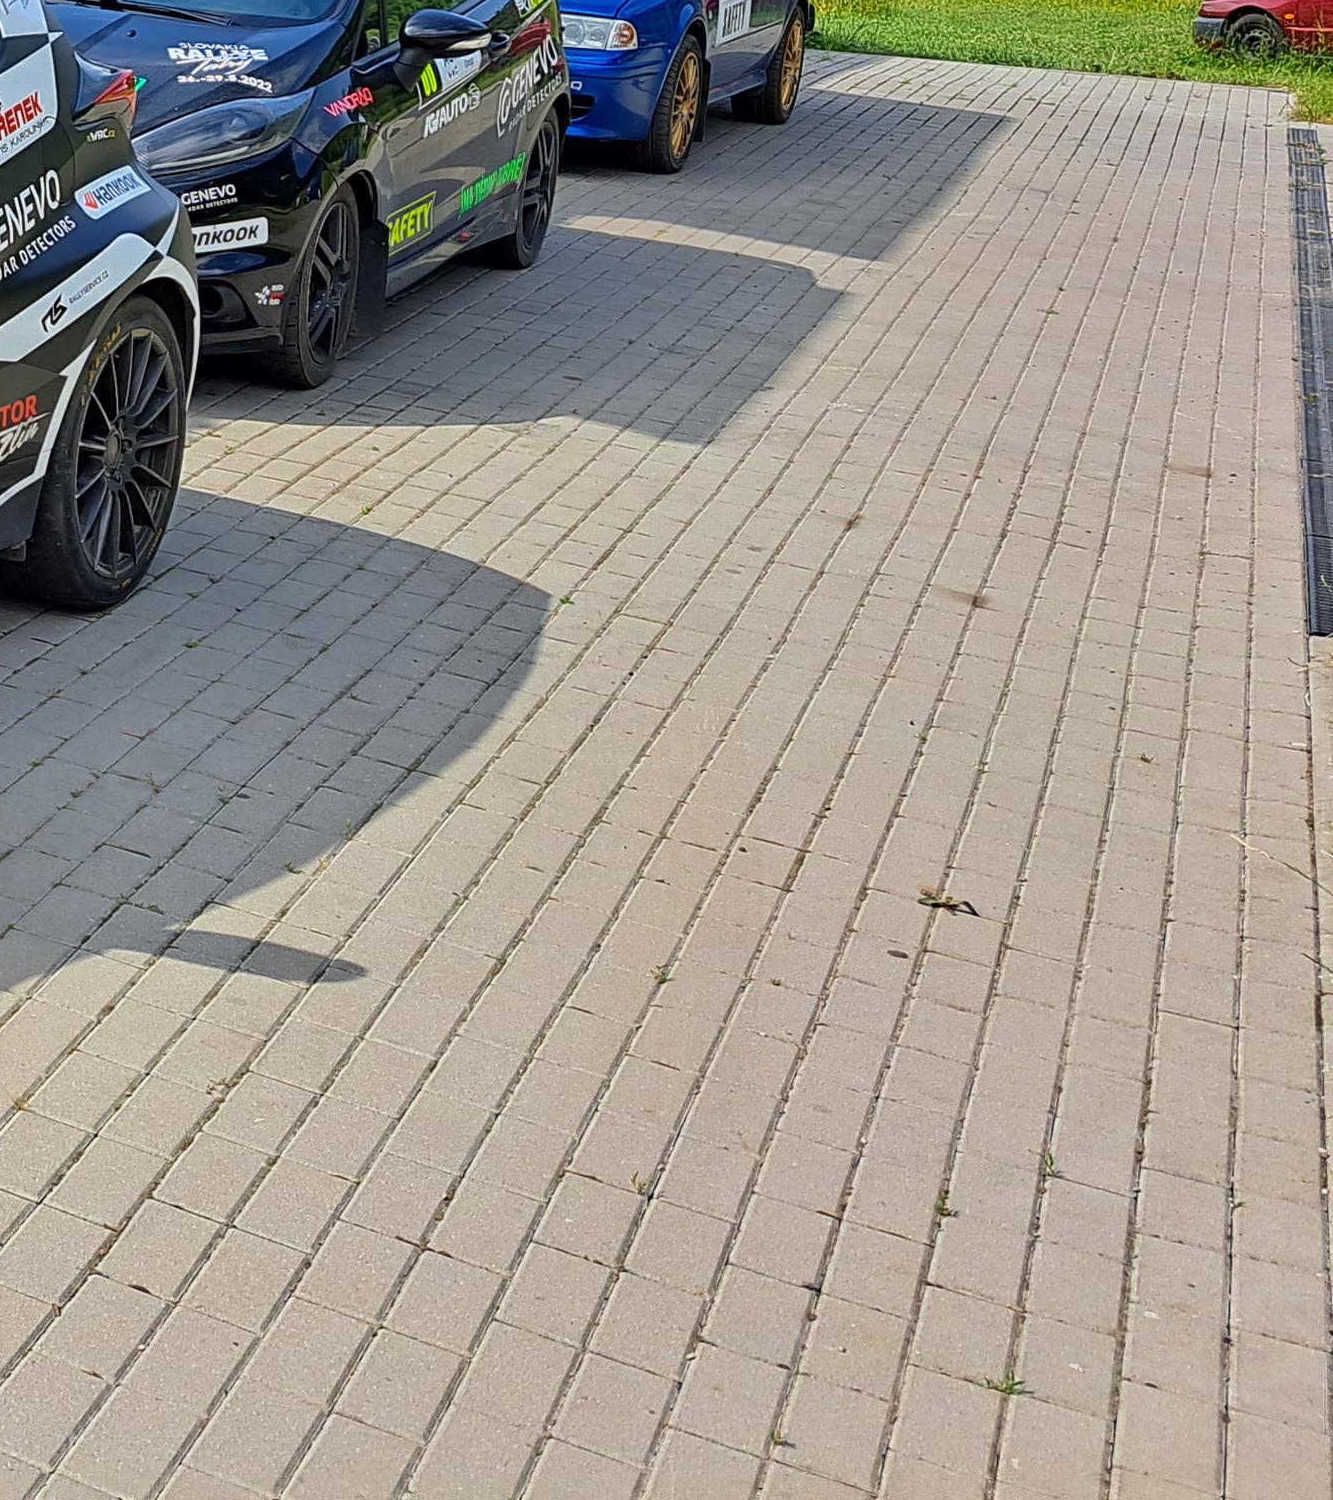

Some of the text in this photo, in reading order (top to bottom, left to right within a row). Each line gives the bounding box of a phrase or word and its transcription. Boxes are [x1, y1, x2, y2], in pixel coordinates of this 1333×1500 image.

[512, 34, 558, 109] GENEVO
[181, 183, 237, 205] GENEVO
[20, 214, 78, 265] DETECTORS
